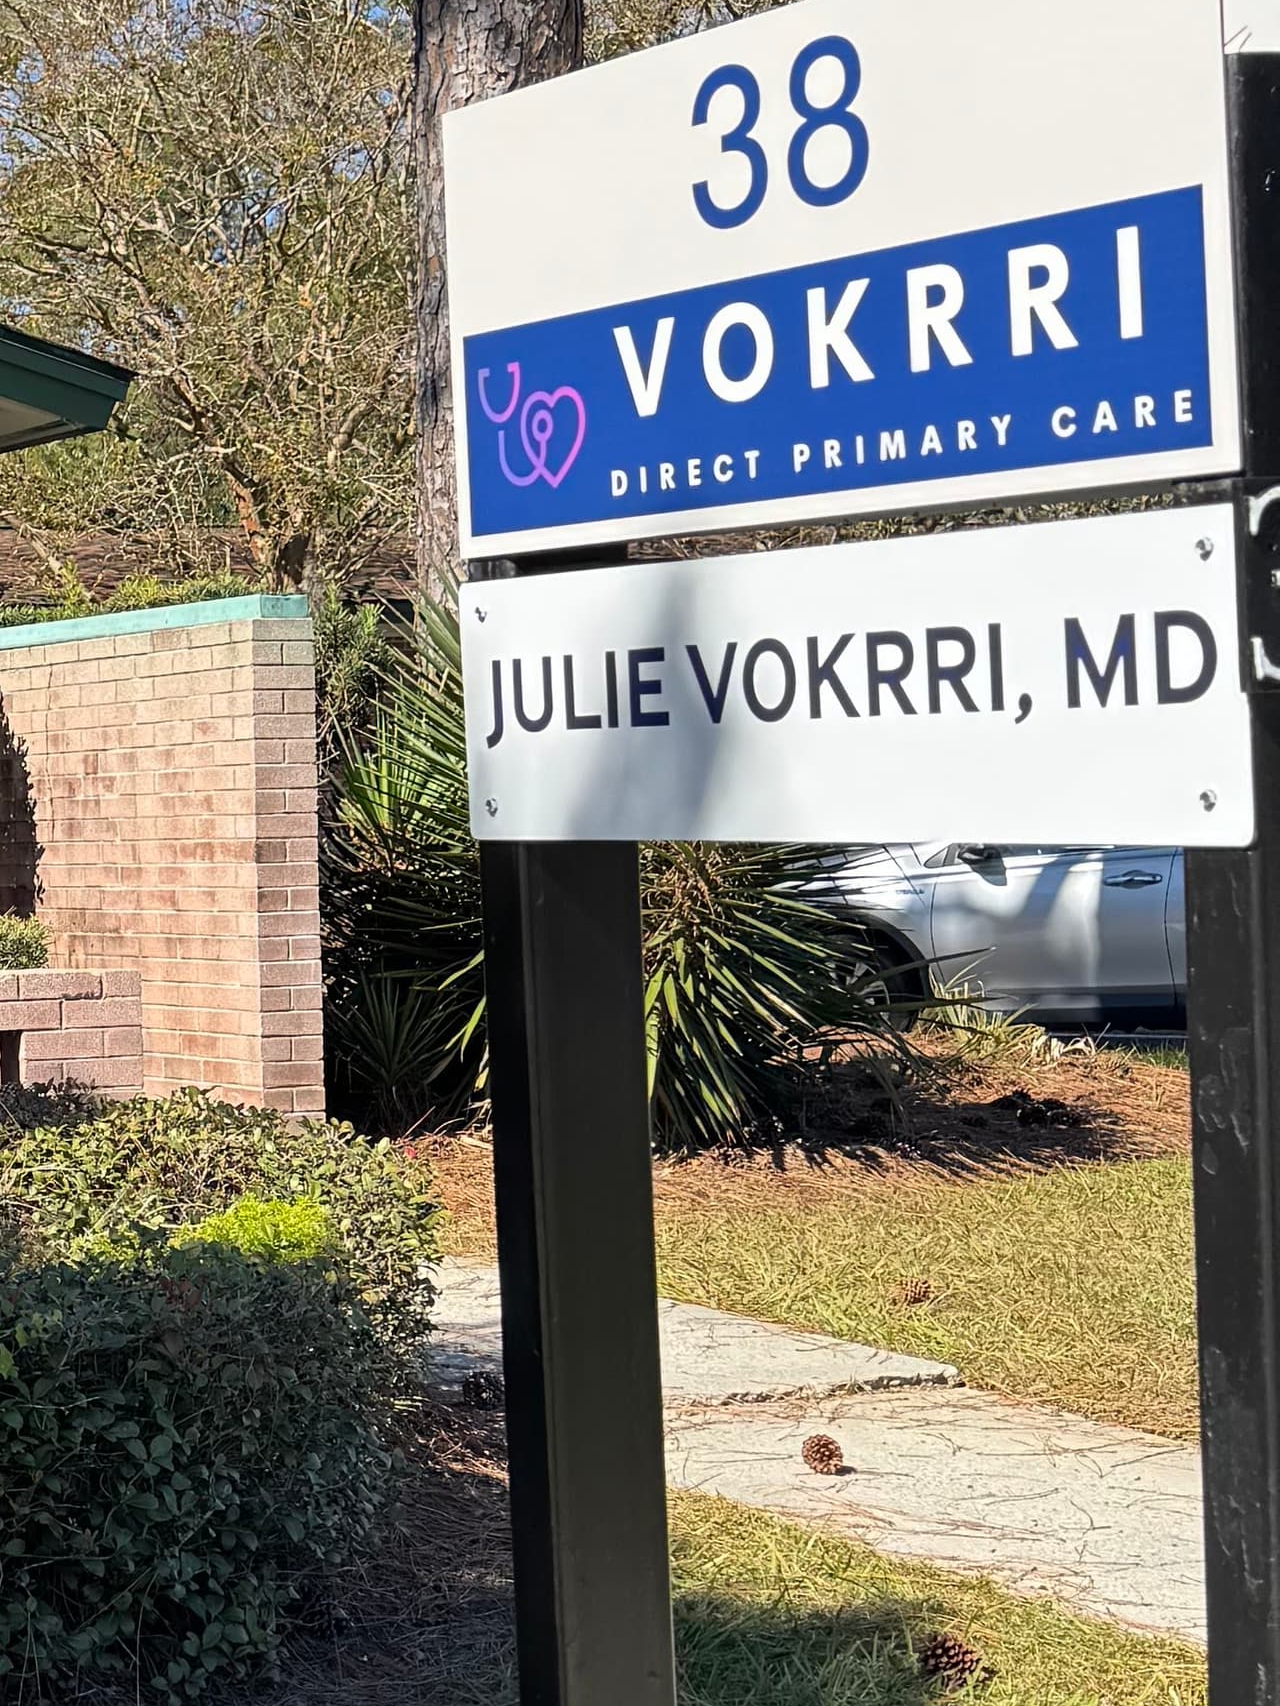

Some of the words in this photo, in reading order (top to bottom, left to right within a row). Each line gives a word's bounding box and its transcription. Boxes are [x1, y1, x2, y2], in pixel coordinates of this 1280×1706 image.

[690, 34, 870, 231] 38
[612, 225, 1144, 417] VOKRRI
[609, 449, 761, 498] DIRECT
[792, 413, 1012, 474] PRIMARY
[1050, 388, 1194, 439] CARE
[485, 645, 672, 750] JULIE
[684, 623, 1033, 726] VOKRRI,
[1064, 610, 1218, 709] MD
